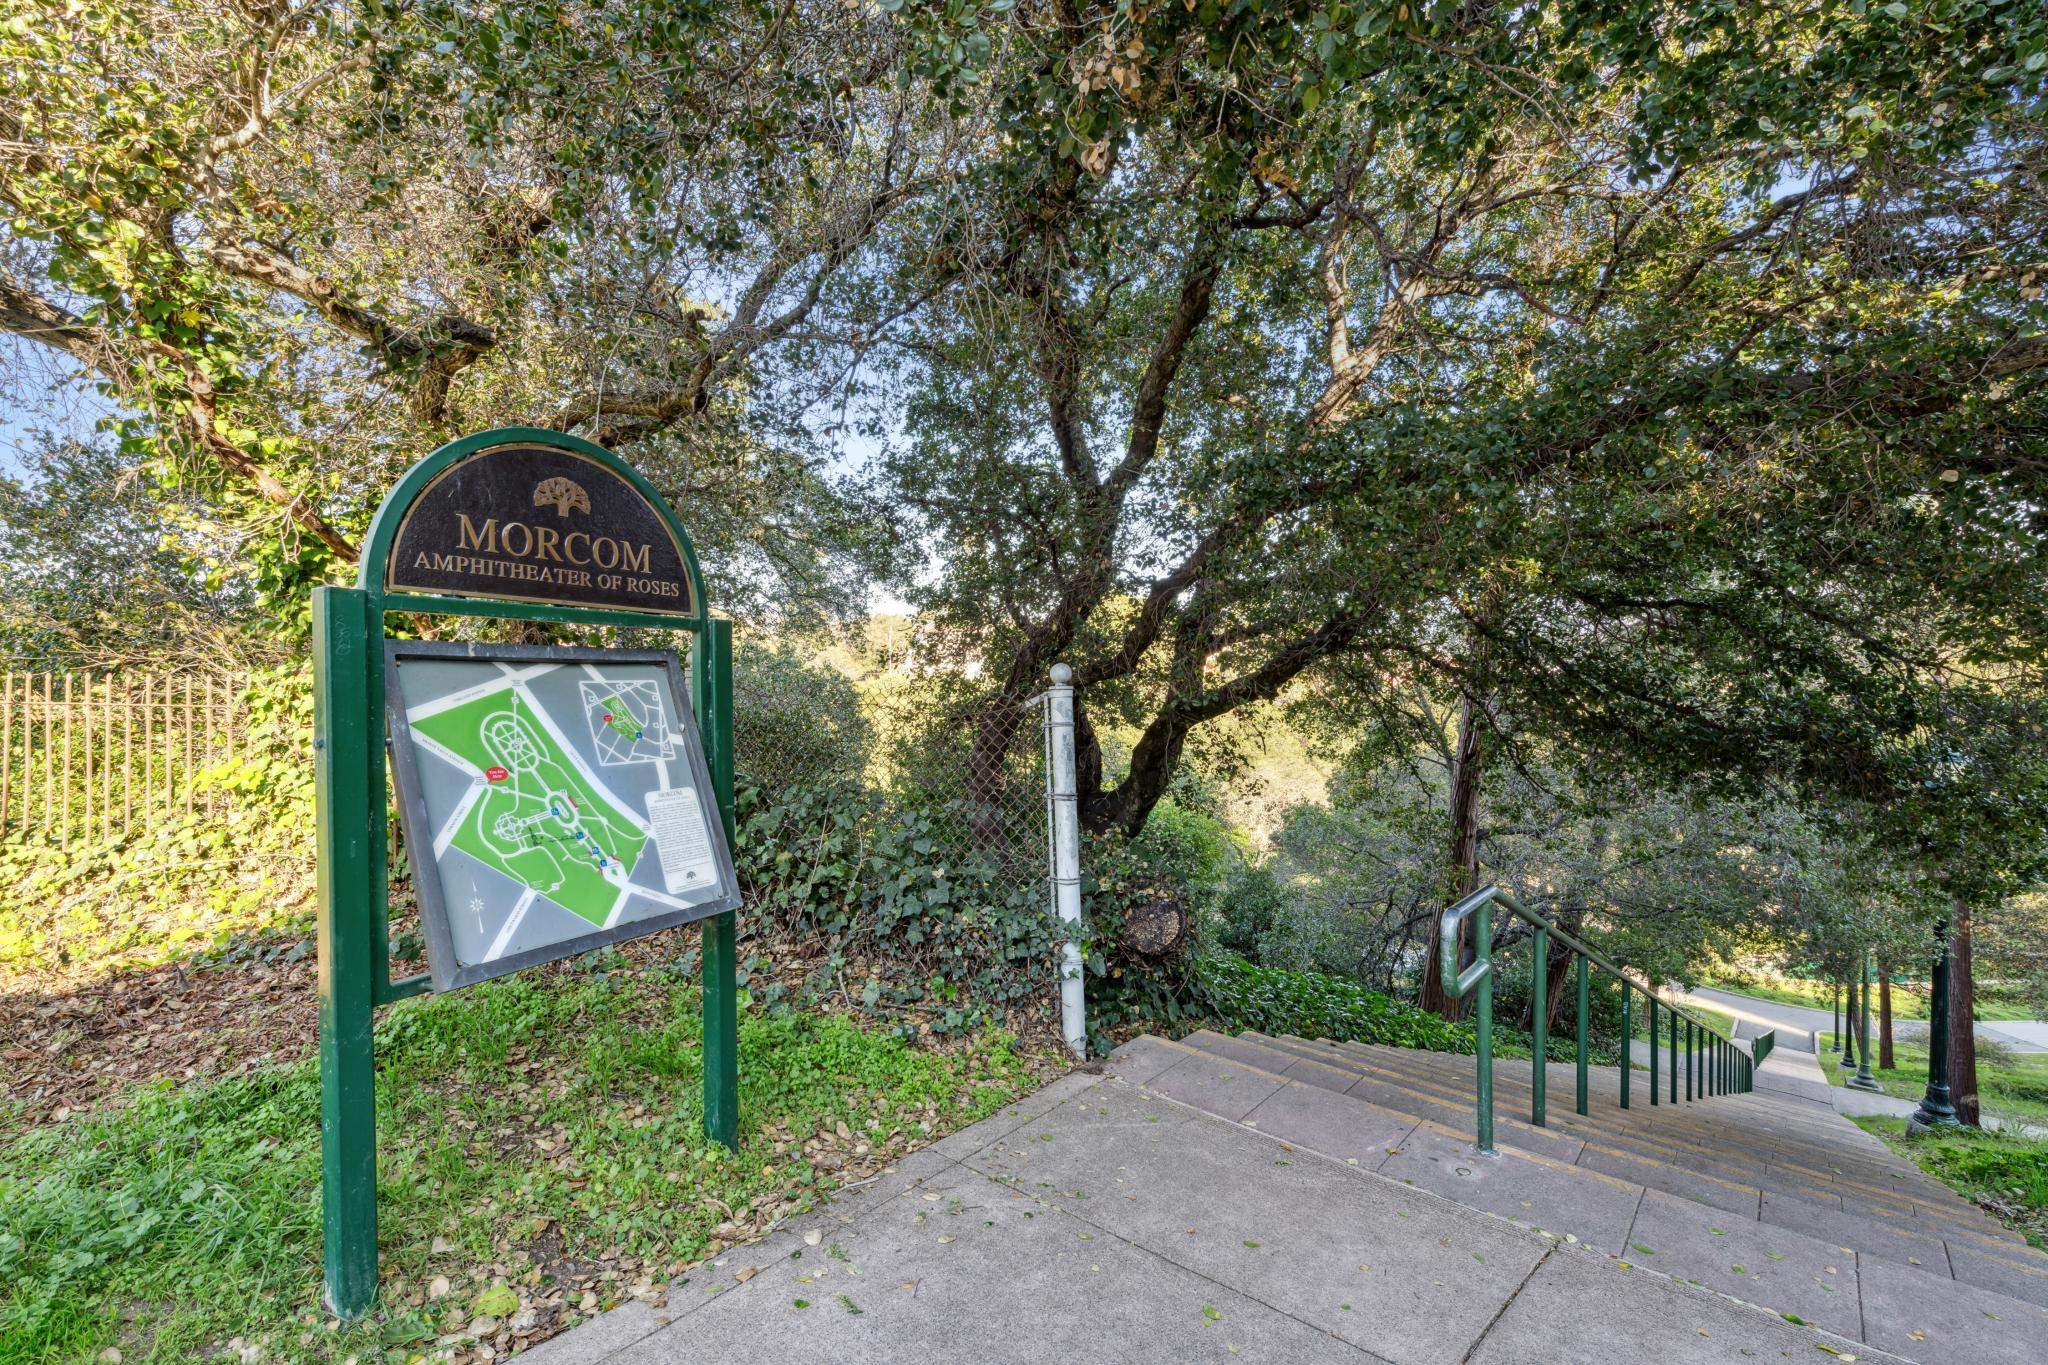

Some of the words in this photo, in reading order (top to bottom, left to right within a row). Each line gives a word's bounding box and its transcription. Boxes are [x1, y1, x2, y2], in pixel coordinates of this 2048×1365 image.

[456, 513, 652, 574] MORCOM
[414, 551, 592, 588] AMPHITHEATER
[597, 574, 622, 590] OF
[627, 577, 680, 597] ROSES
